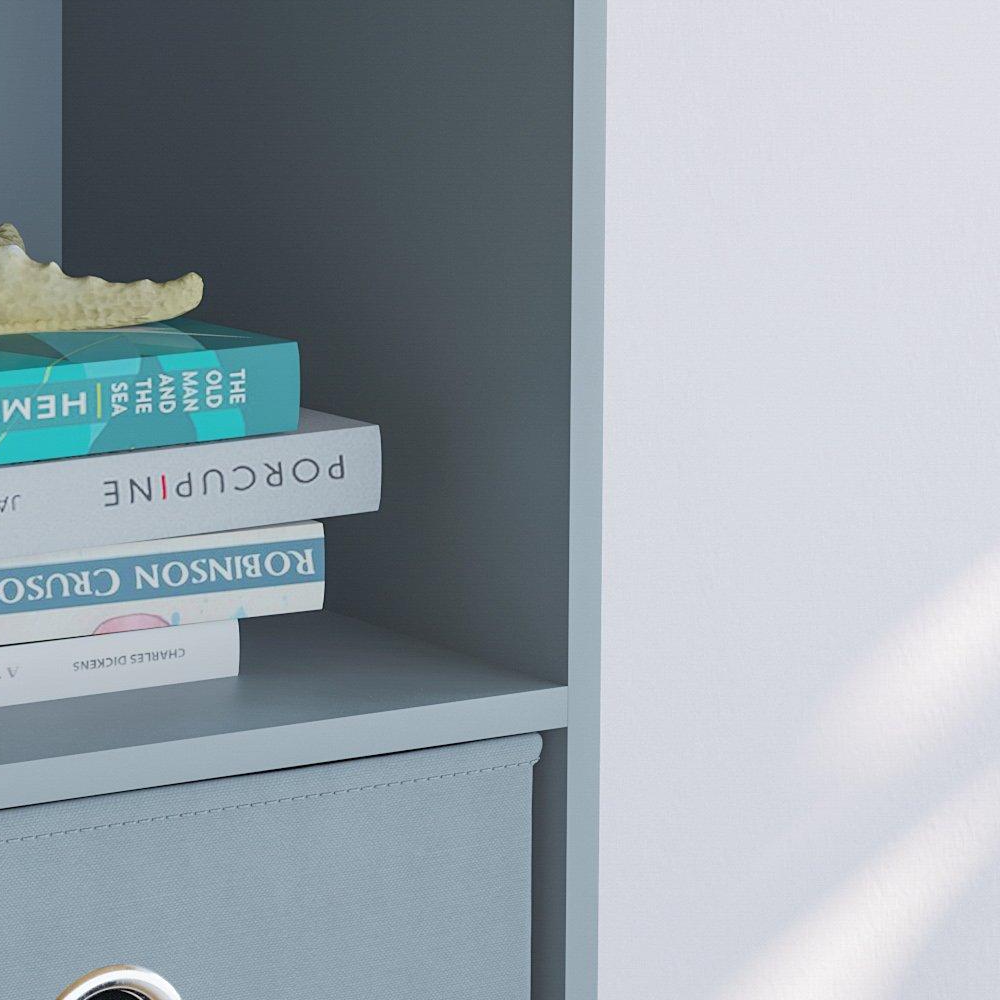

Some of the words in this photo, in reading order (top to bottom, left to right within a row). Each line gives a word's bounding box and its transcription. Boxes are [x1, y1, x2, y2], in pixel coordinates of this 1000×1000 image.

[111, 381, 129, 418] SEA
[135, 376, 152, 415] THE
[159, 373, 177, 414] AND
[181, 371, 199, 413] MAN
[205, 369, 223, 409] OLD
[229, 367, 247, 405] THE
[103, 454, 346, 508] PORCUPINE
[134, 548, 316, 590] ROBINSON
[6, 666, 20, 678] A
[73, 655, 127, 672] DICKENS
[131, 648, 186, 665] CHARLES
